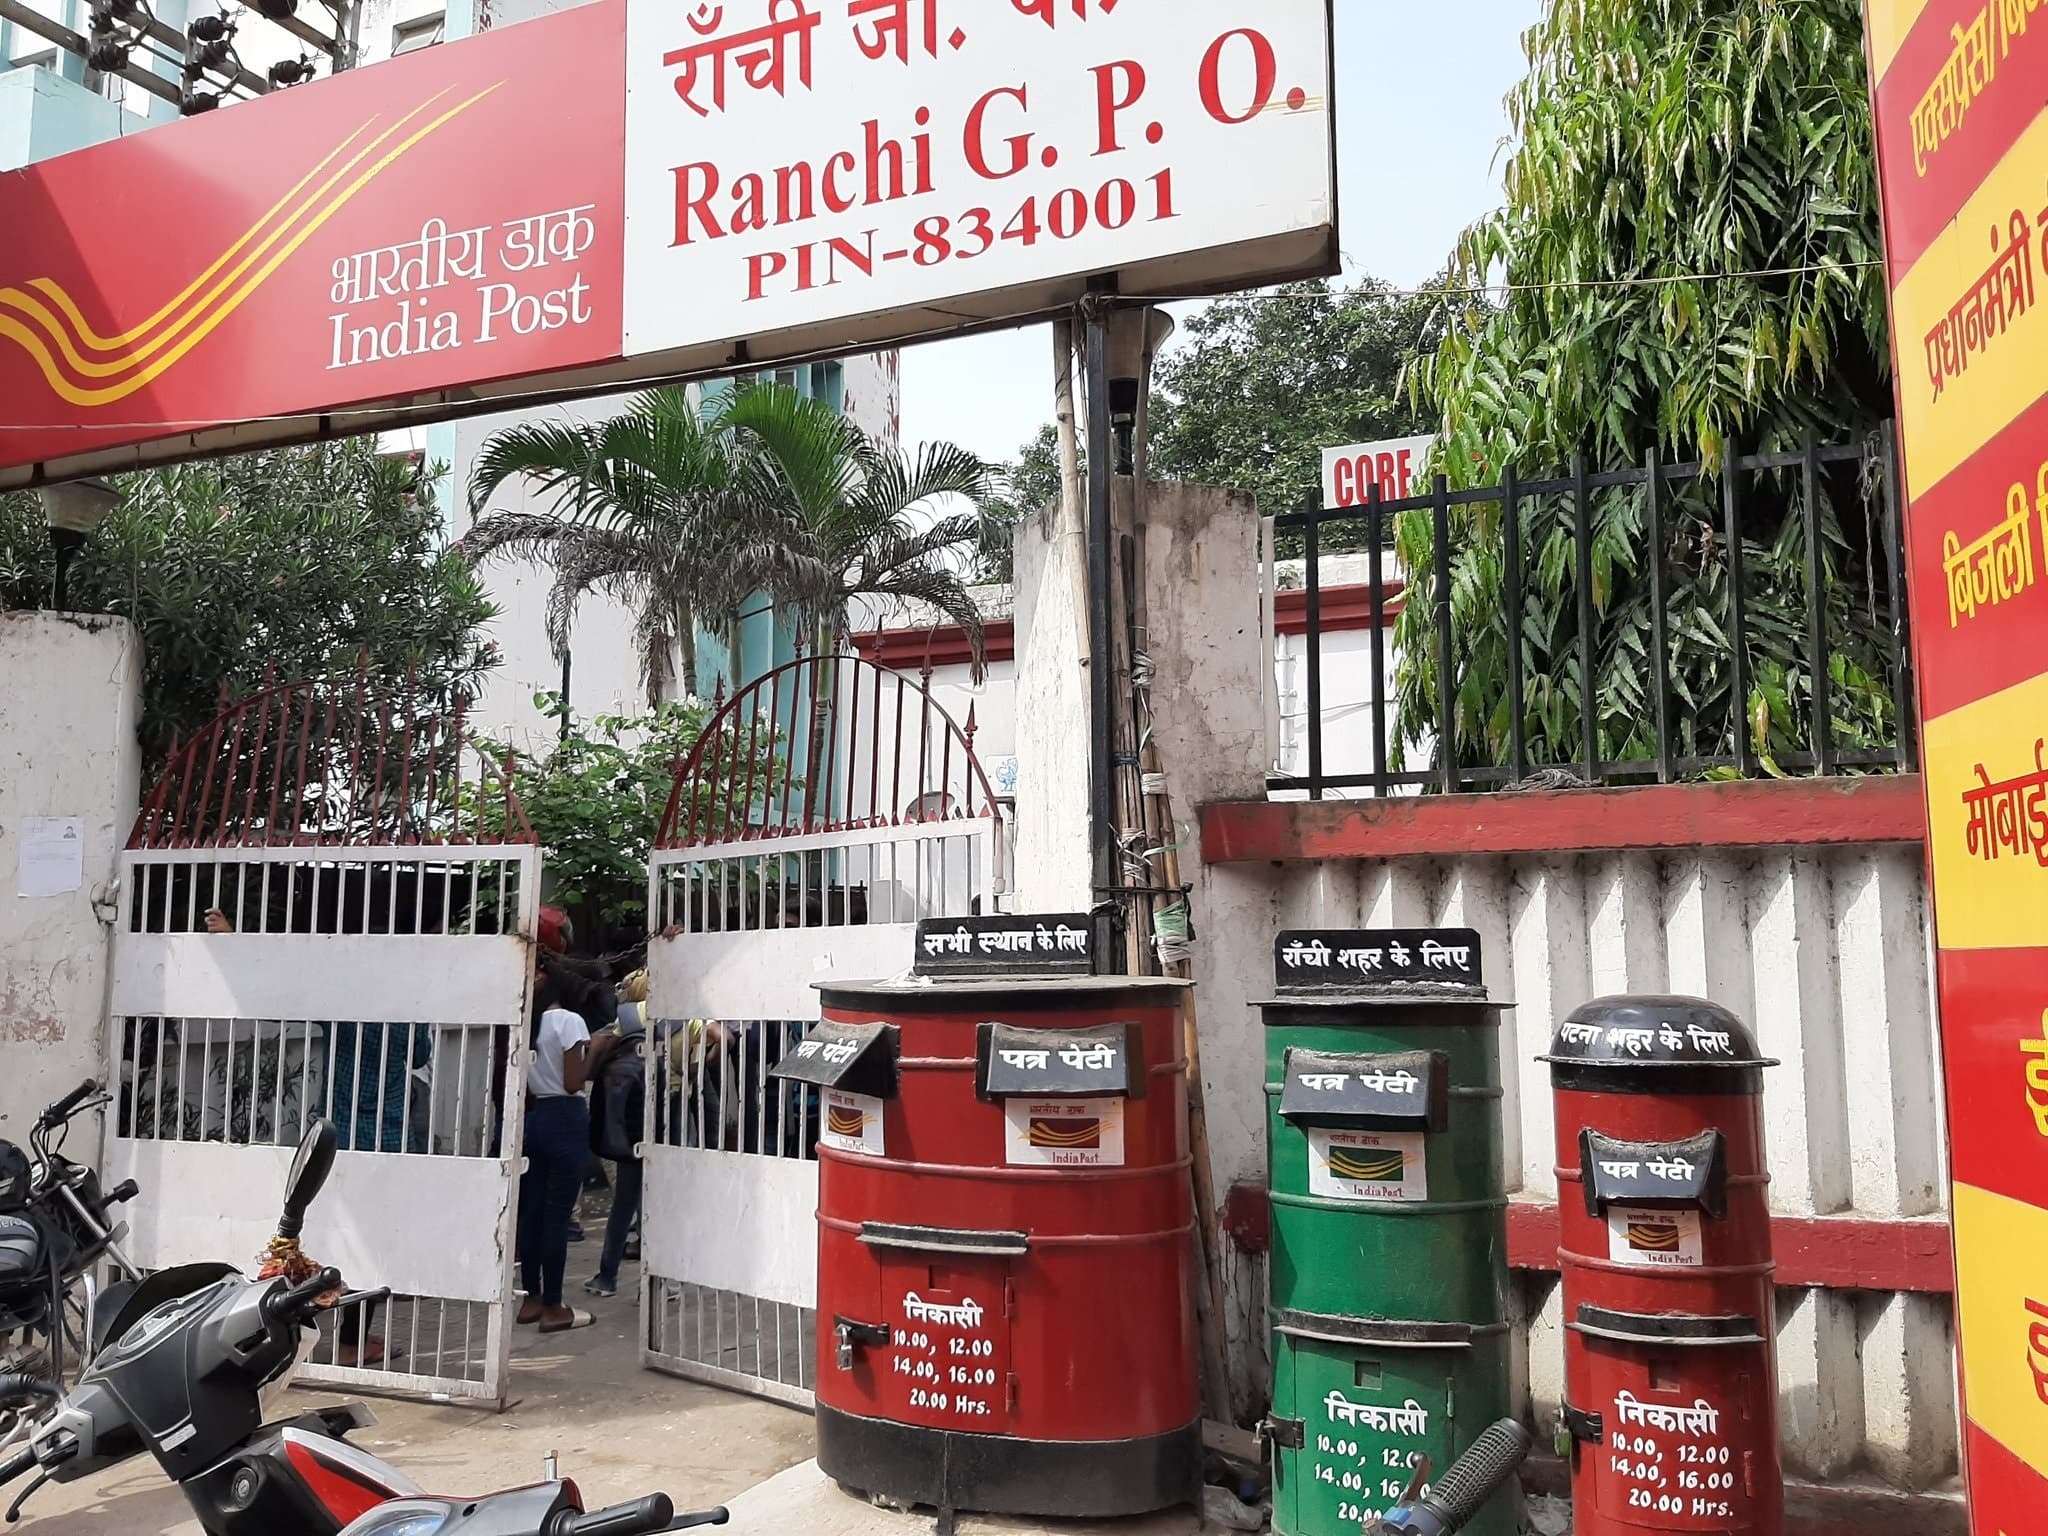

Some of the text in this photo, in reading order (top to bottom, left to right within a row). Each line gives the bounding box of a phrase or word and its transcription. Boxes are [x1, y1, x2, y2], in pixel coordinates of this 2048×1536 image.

[666, 28, 1306, 249] Ranchi G. P. O.
[741, 167, 1181, 302] PIN-834001
[330, 204, 595, 304] भारतीय डाक
[326, 272, 592, 370] India Post
[1924, 209, 2034, 404] प्रधानमंत्री
[1334, 449, 1411, 507] CORE
[1943, 482, 2034, 628] बिजली
[977, 930, 1035, 953] स्थान
[1036, 923, 1053, 951] के
[1054, 924, 1088, 954] लिए
[1337, 948, 1382, 975] शहर
[1389, 940, 1411, 967] के
[1419, 939, 1470, 972] लिए
[1560, 1022, 1734, 1056] पटना शहर के लिए
[999, 1043, 1117, 1071] पत्र पेटी
[1298, 1069, 1419, 1094] पत्र पेटी
[1599, 1156, 1695, 1181] पत्र पेटी
[903, 1291, 983, 1329] निकासी
[949, 1337, 993, 1356] 12.00
[893, 1355, 995, 1385] 14.00, 16.00
[909, 1388, 990, 1415] 20.00 Hrs.
[1323, 1390, 1428, 1436] निकासी
[1614, 1389, 1719, 1437] निकासी
[1611, 1455, 1734, 1489] 14.00, 16.00
[1678, 1445, 1729, 1465] 12.00
[1629, 1488, 1734, 1516] 20.00 Hrs.
